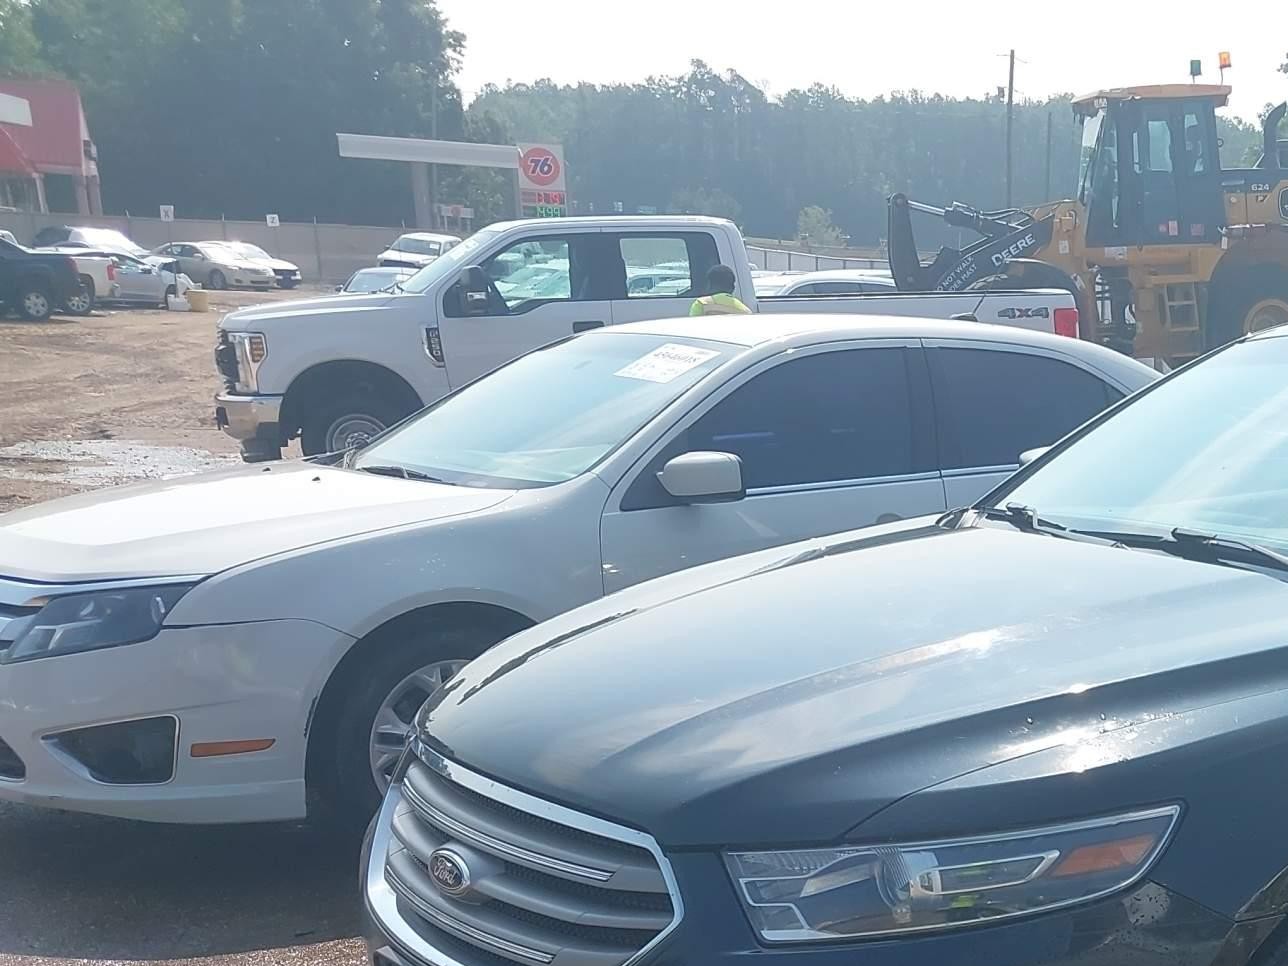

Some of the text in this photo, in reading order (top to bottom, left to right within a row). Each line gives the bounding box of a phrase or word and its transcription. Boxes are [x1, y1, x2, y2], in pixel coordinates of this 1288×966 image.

[528, 156, 553, 176] 76
[1251, 183, 1270, 191] 624
[991, 234, 1036, 267] DEERE
[434, 857, 459, 885] Ford
